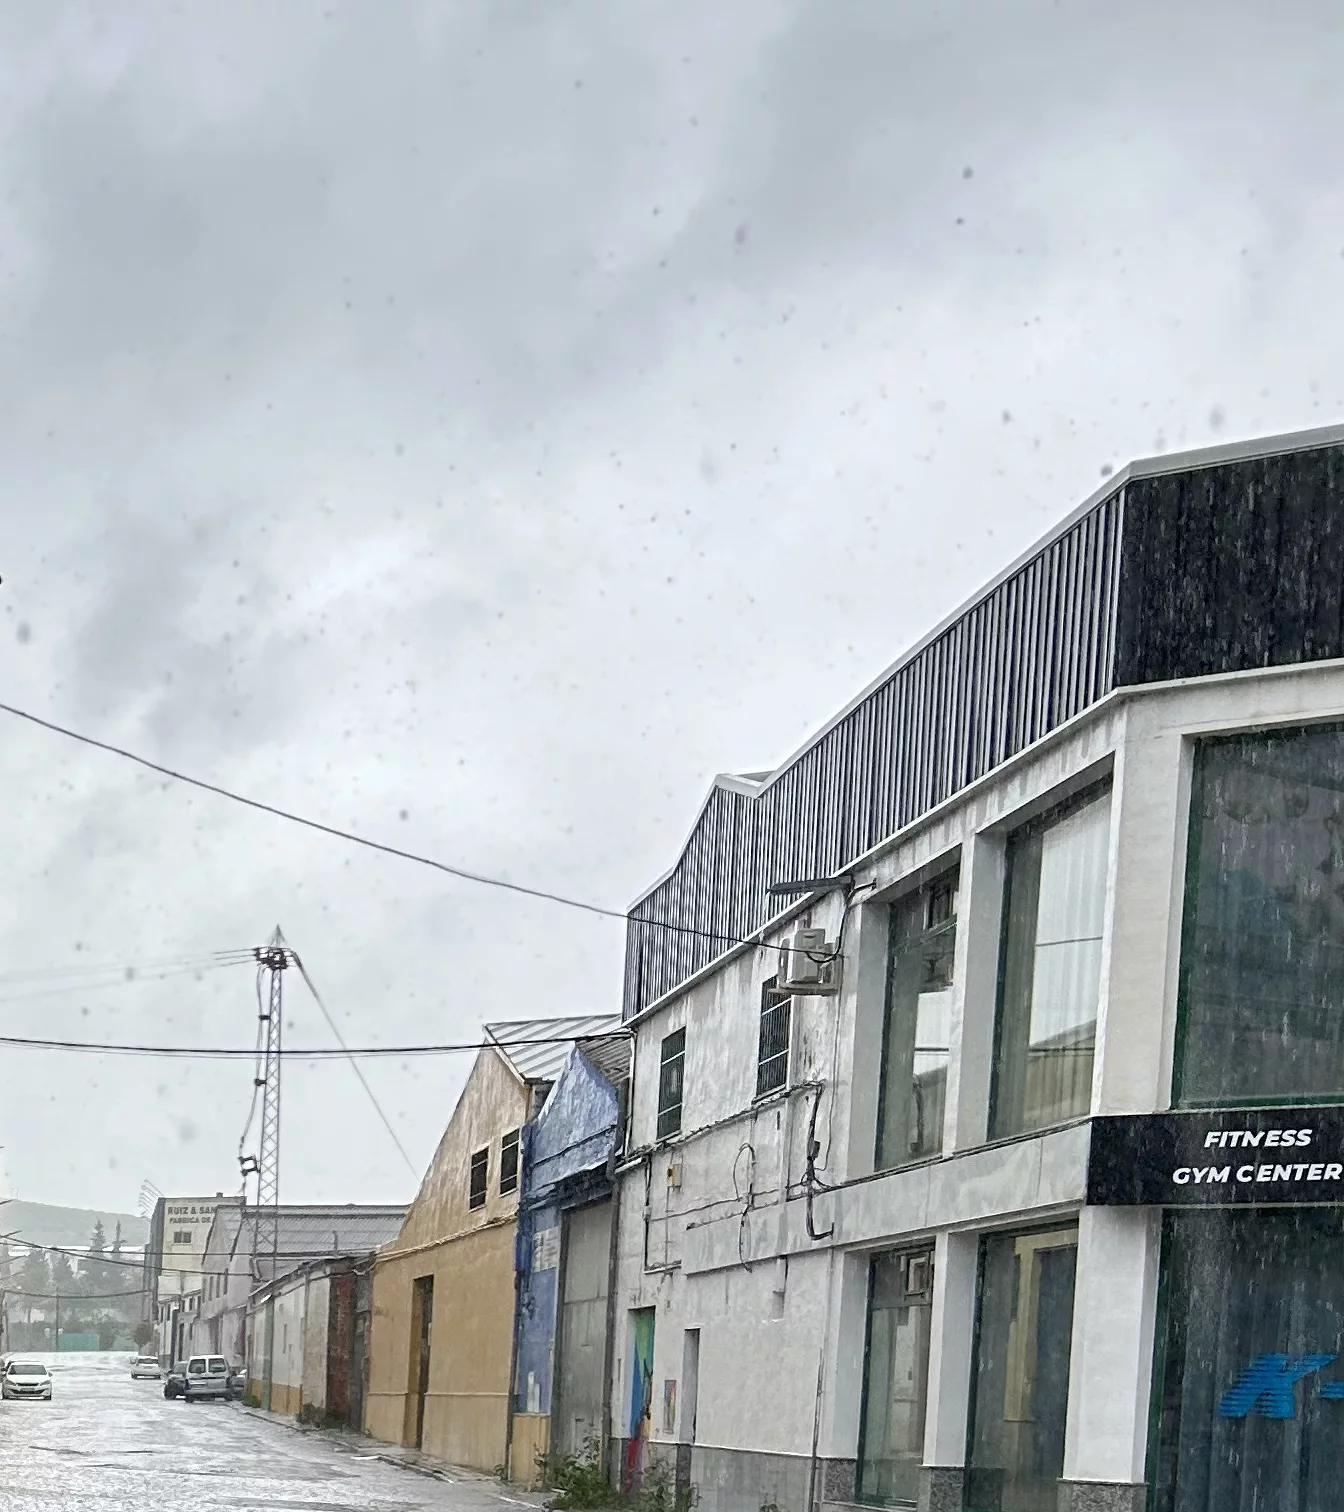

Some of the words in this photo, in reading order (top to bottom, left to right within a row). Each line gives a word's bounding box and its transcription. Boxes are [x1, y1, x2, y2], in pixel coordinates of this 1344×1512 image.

[1203, 1129, 1313, 1148] FITNESS
[1173, 1166, 1231, 1185] GYM
[1236, 1163, 1343, 1183] CENTER
[168, 1207, 189, 1215] RUIZ
